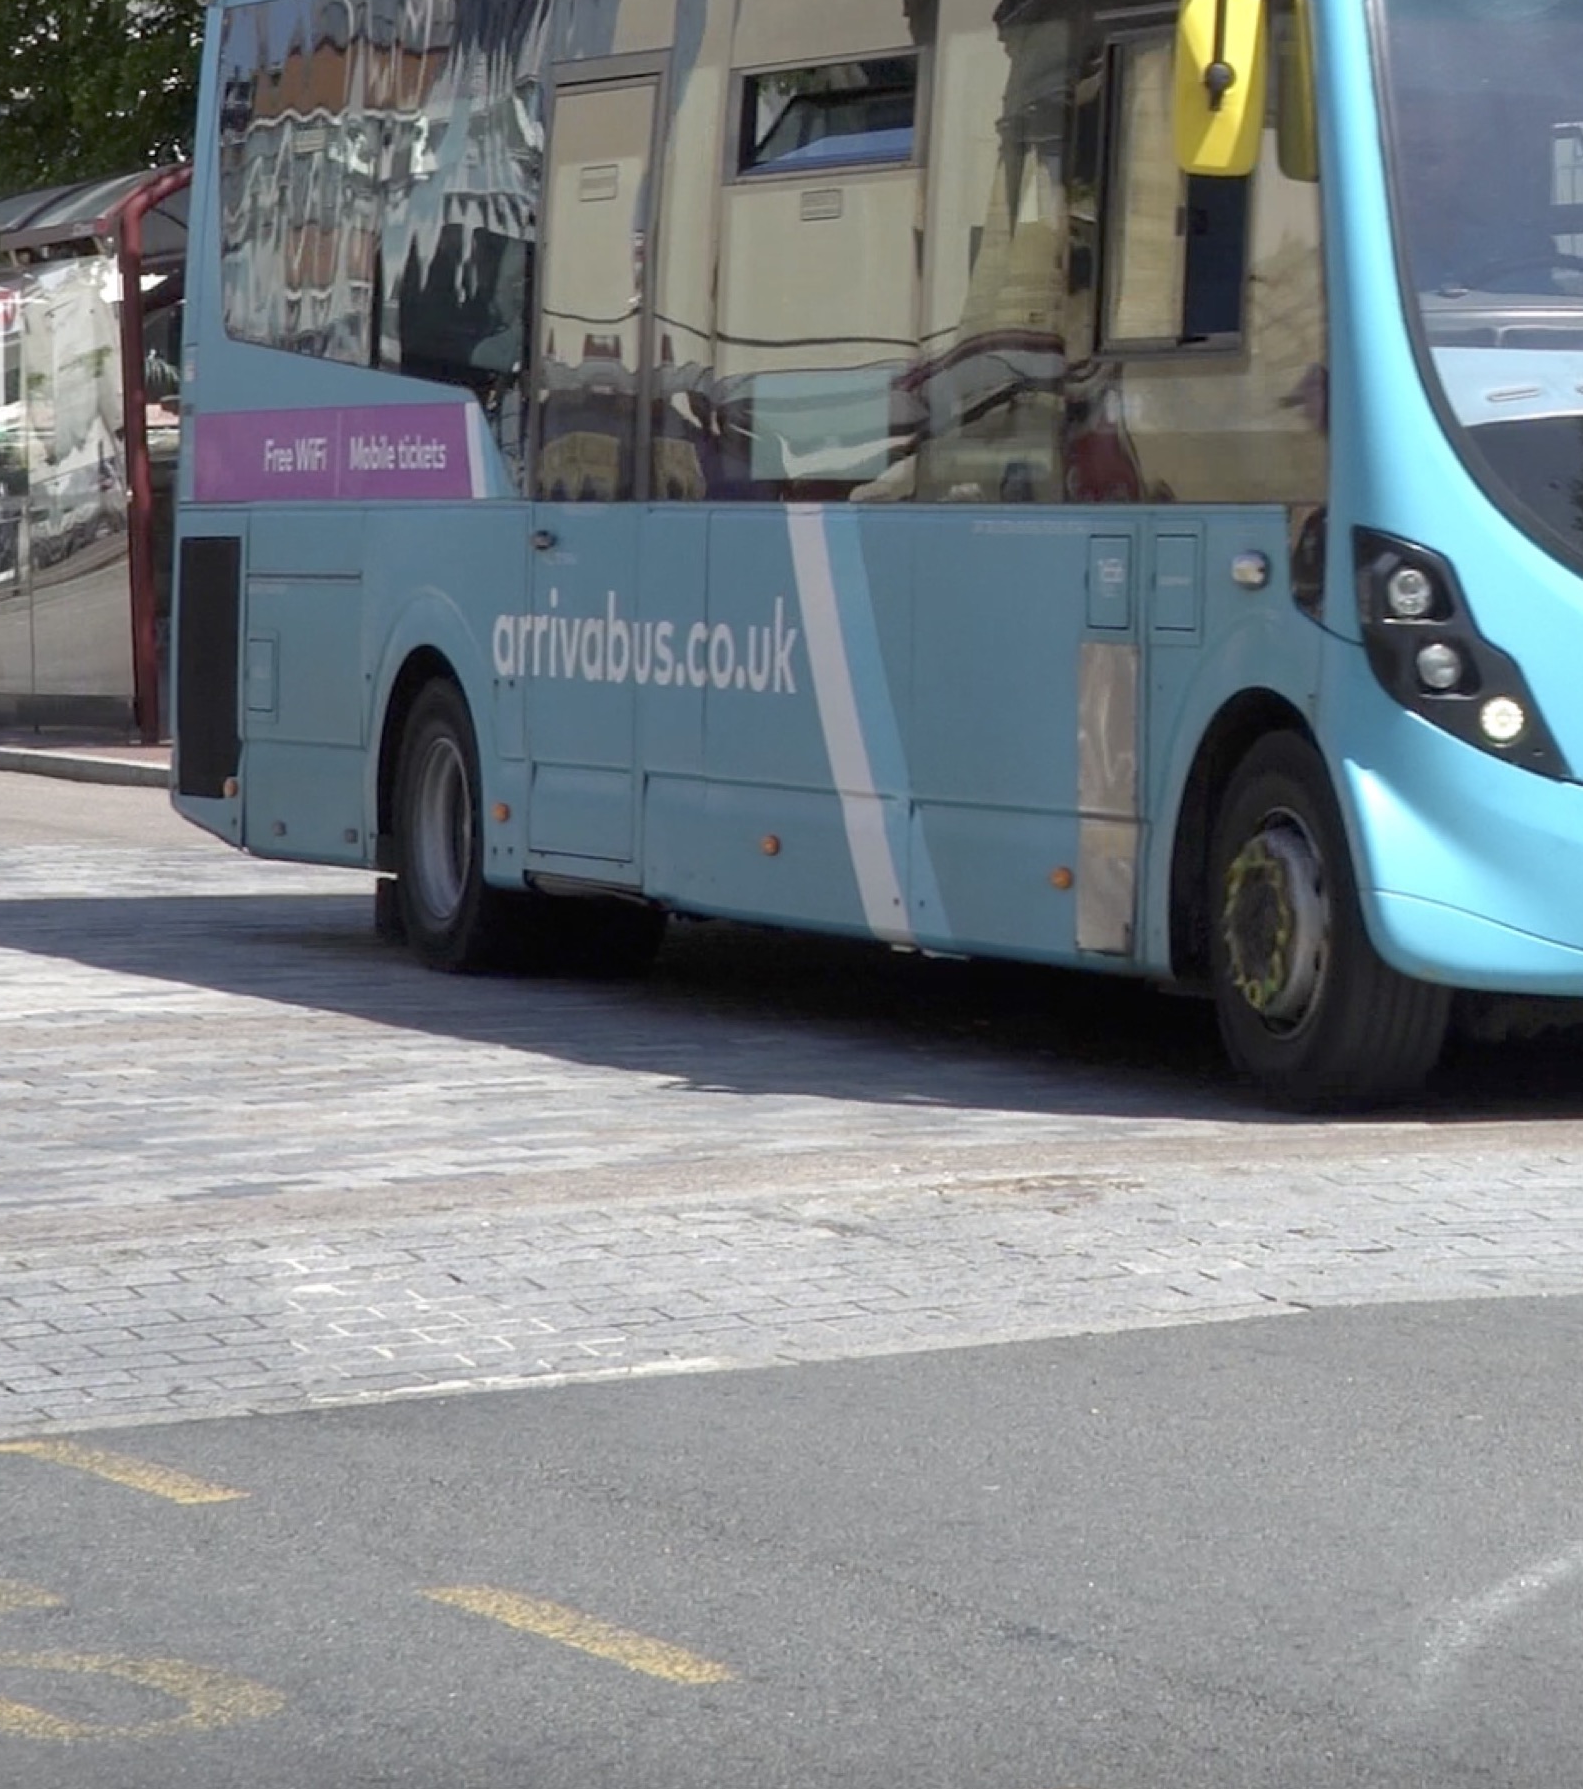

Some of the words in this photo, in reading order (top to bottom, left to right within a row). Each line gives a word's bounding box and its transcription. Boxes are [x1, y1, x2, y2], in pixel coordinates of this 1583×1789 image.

[263, 438, 294, 473] Free
[295, 437, 328, 472] WiFi
[348, 434, 396, 471] Mobile
[397, 434, 447, 470] tickets
[492, 586, 797, 694] arrivabus.co.uk
